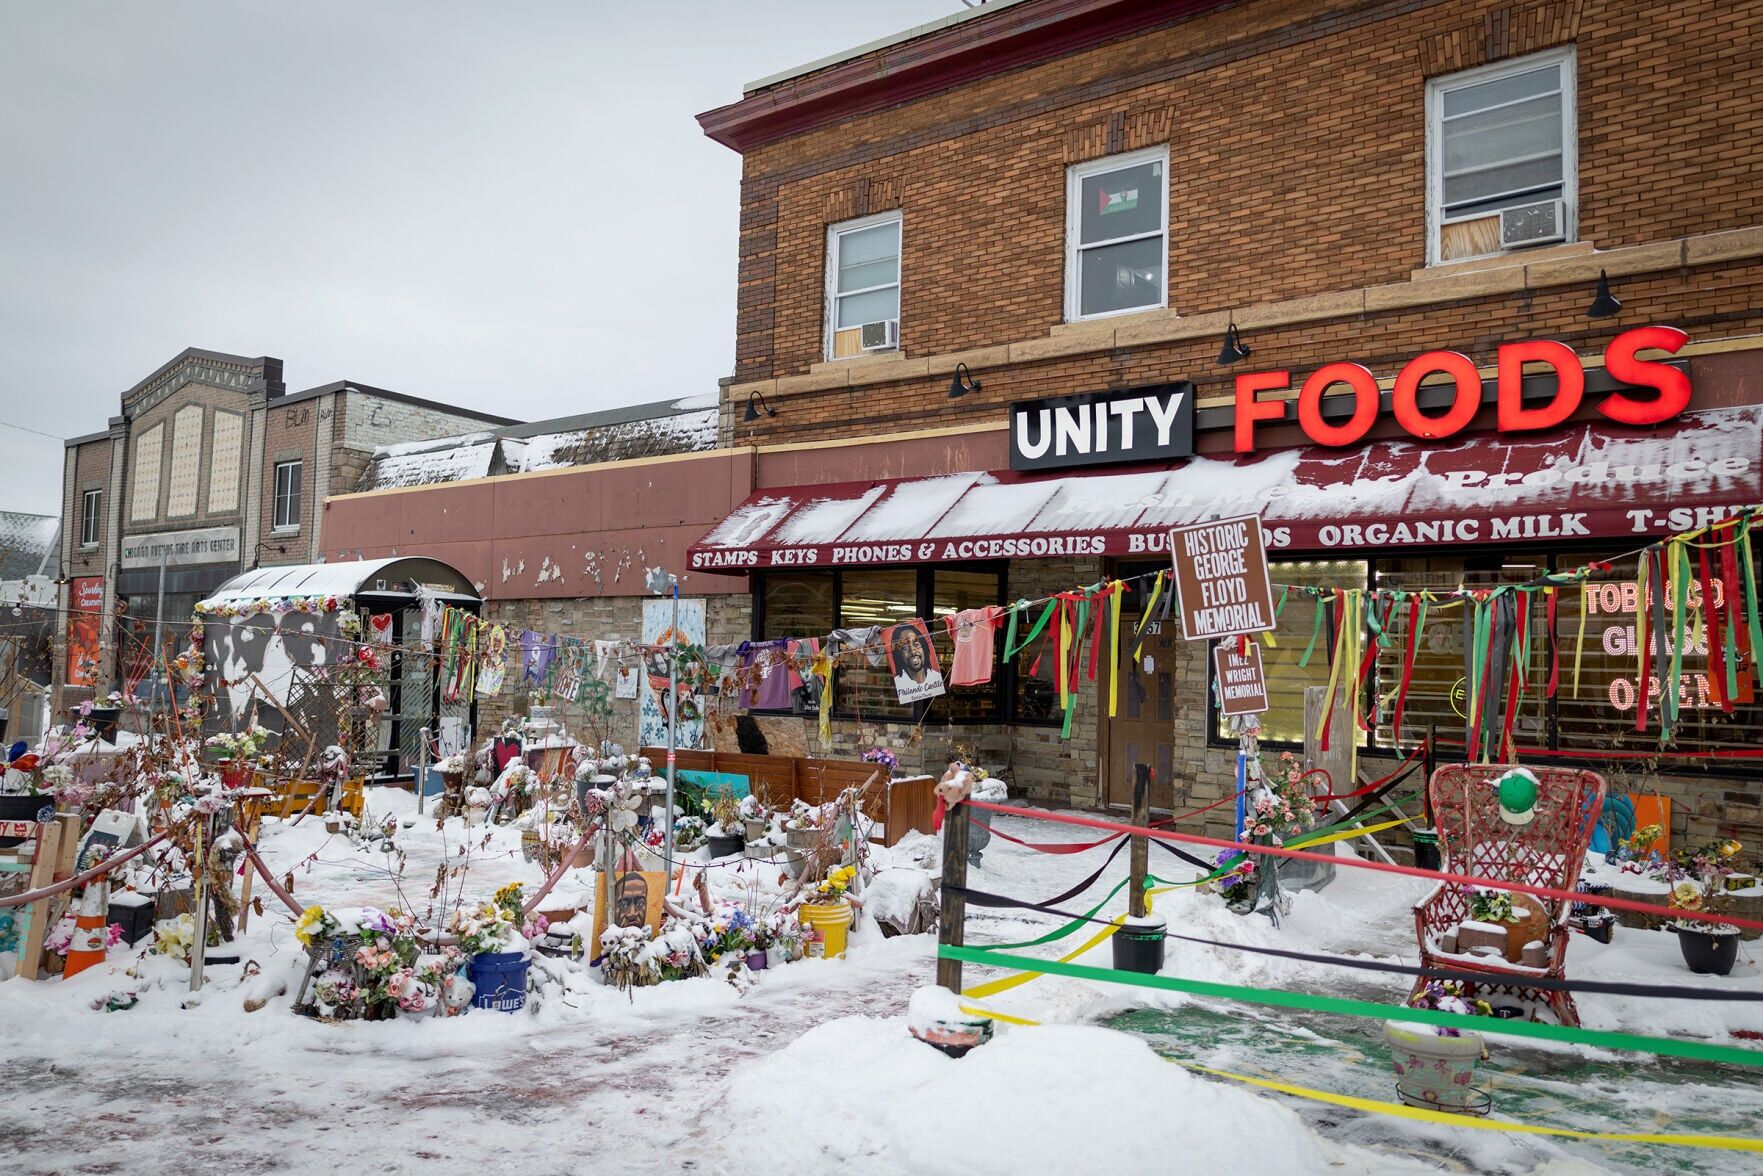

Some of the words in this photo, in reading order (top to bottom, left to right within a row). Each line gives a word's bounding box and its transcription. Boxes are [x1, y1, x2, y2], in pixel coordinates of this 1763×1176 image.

[1235, 326, 1693, 453] FOODS
[1017, 393, 1185, 459] UNITY
[1445, 456, 1750, 490] Produce
[124, 546, 149, 559] CHICAGO
[191, 541, 208, 553] ARTS
[210, 538, 235, 553] CENTER
[693, 549, 758, 568] STAMPS
[771, 547, 818, 566] KEYS
[832, 544, 913, 563] PHONES
[918, 542, 936, 560] &
[941, 536, 1106, 560] ACCESSORIES
[1318, 519, 1480, 547] ORGANIC
[1490, 512, 1592, 541] MILK
[1184, 522, 1249, 557] HISTORIC
[1193, 548, 1248, 581] GEORGE
[1201, 576, 1247, 608] FLOYD
[1134, 621, 1160, 635] 357
[1193, 602, 1266, 635] MEMORIAL
[898, 685, 923, 697] Philando
[924, 680, 943, 691] Castile
[1224, 682, 1265, 700] MEMORIAL
[1225, 667, 1257, 684] WRIGHT
[485, 996, 525, 1010] LOWE'S
